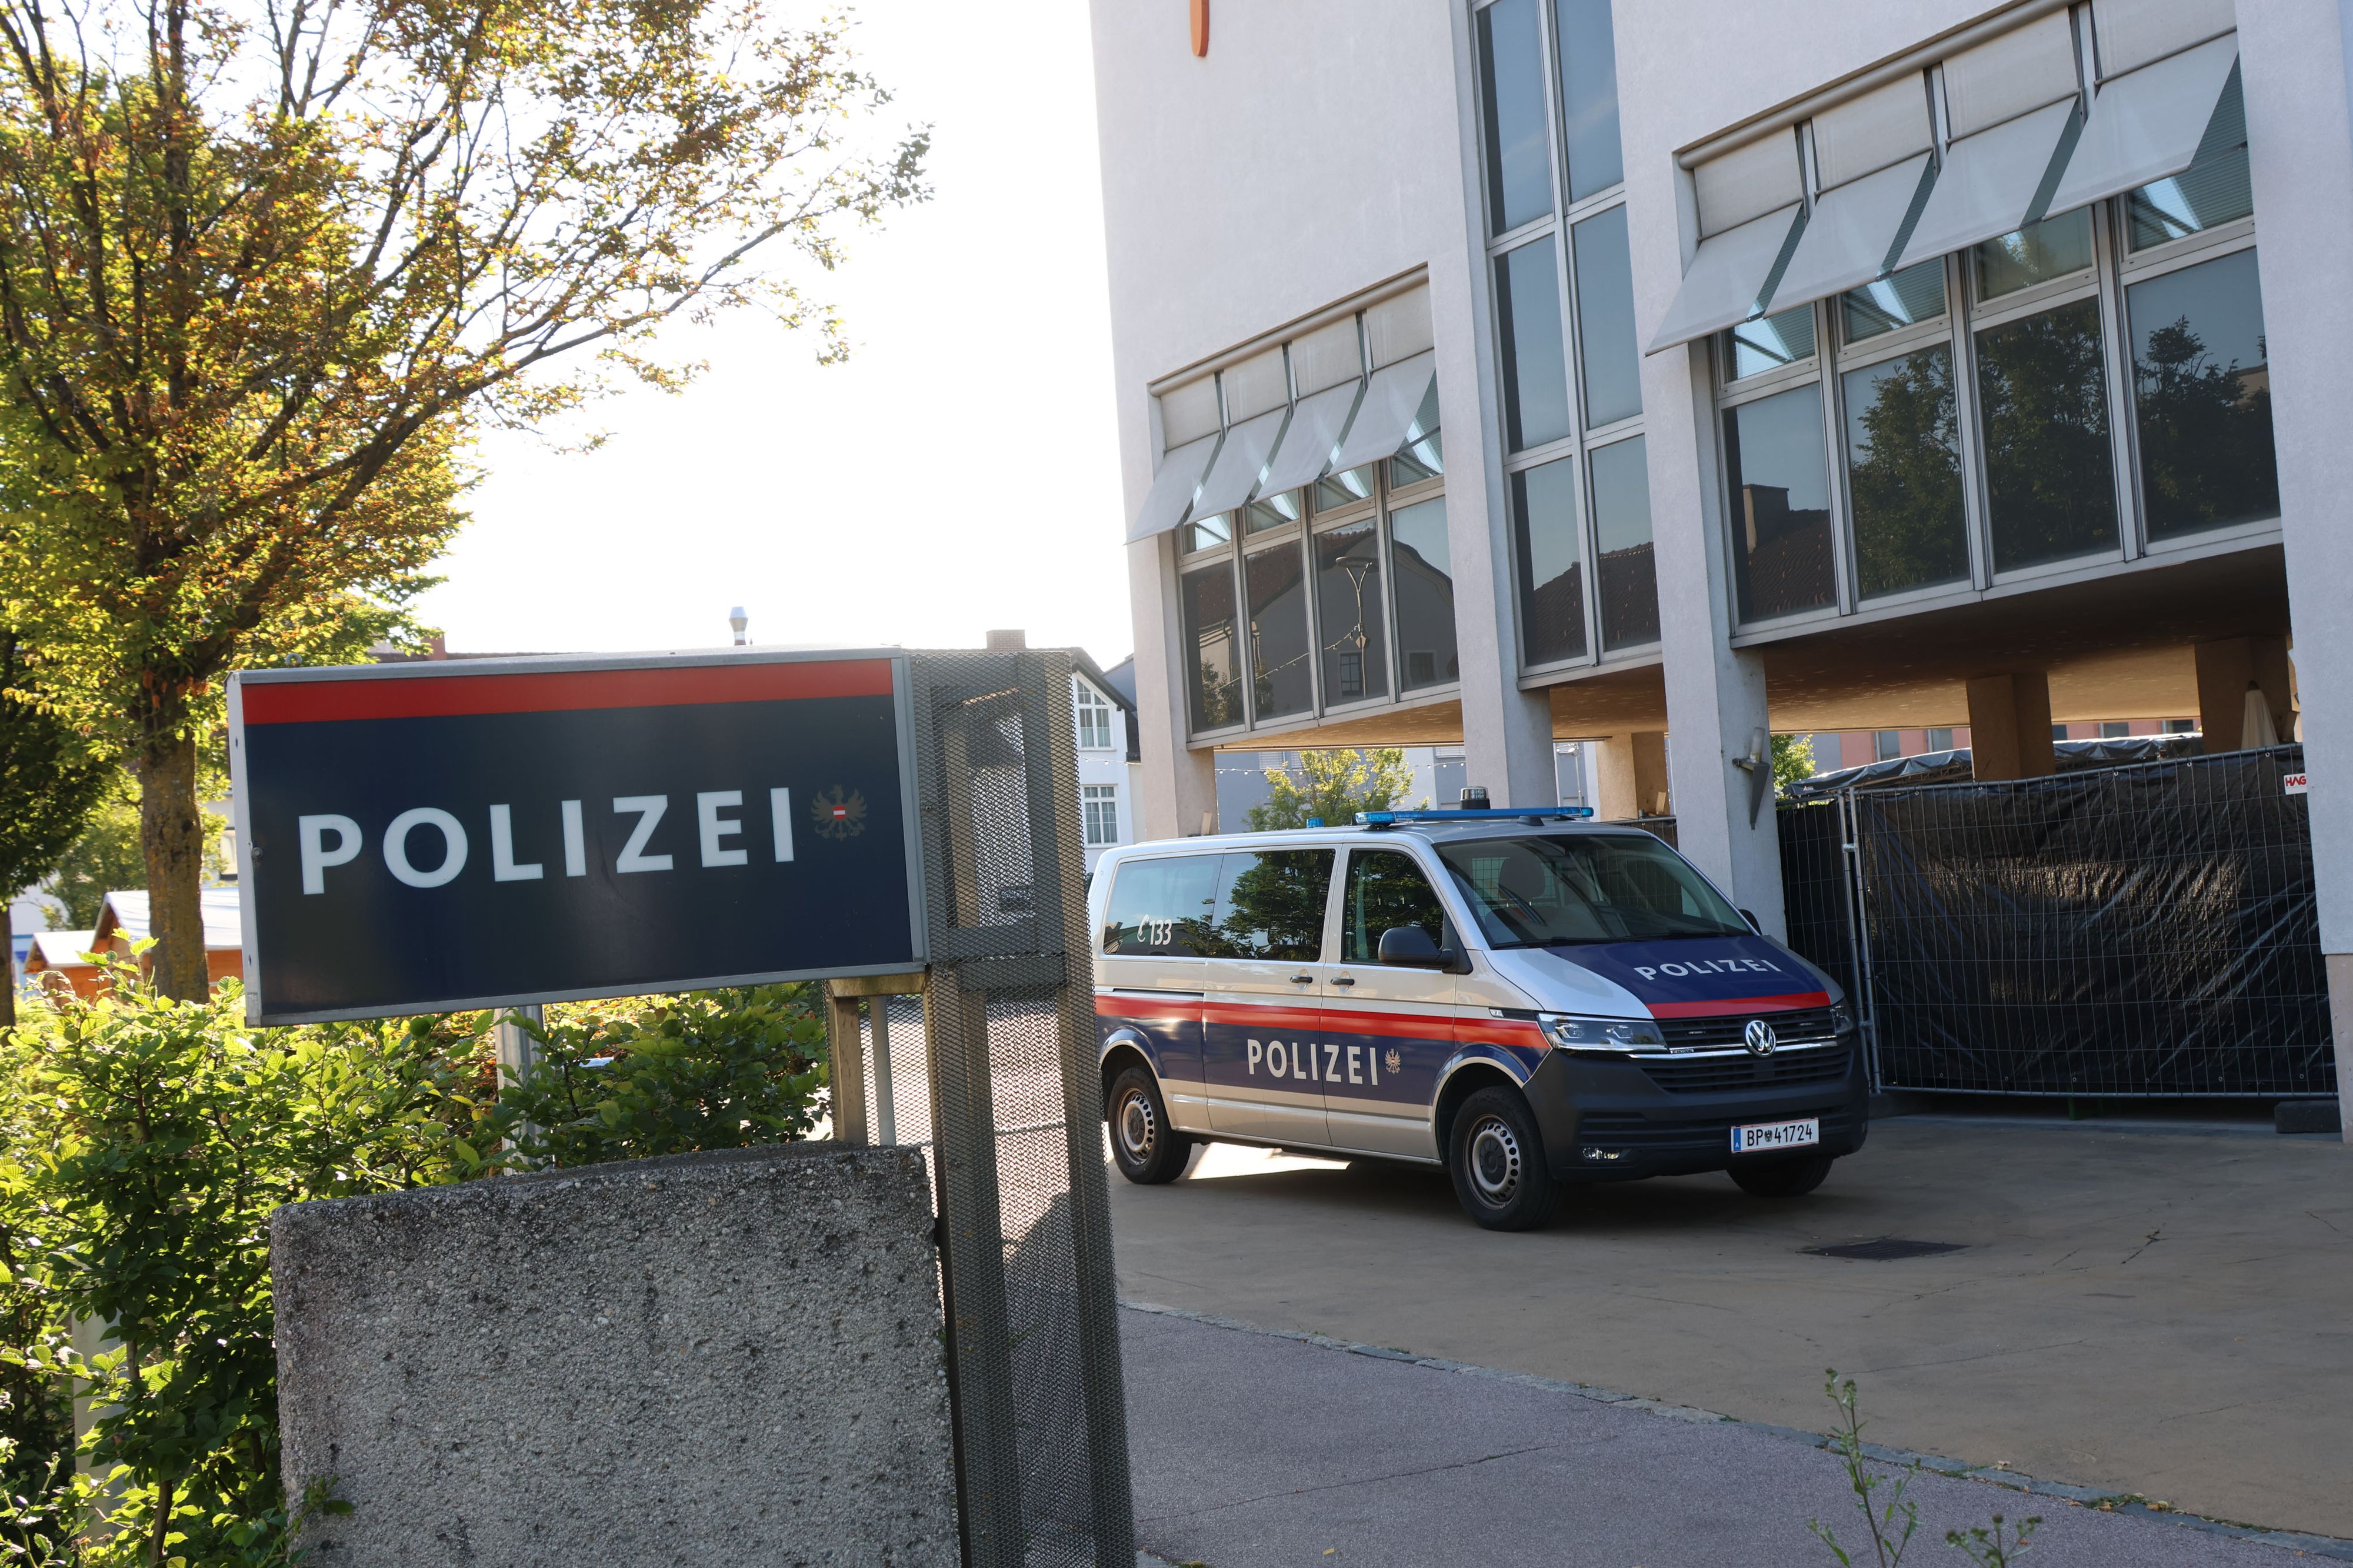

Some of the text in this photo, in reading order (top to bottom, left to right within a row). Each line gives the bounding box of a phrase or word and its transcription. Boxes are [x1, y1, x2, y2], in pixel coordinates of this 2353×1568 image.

[299, 788, 794, 895] POLIZEI
[1149, 919, 1172, 945] 133
[1634, 959, 1782, 980] POLIZEI
[1247, 1039, 1378, 1086] POLIZEI
[1747, 1129, 1763, 1146] BP
[1774, 1123, 1812, 1143] 41724
